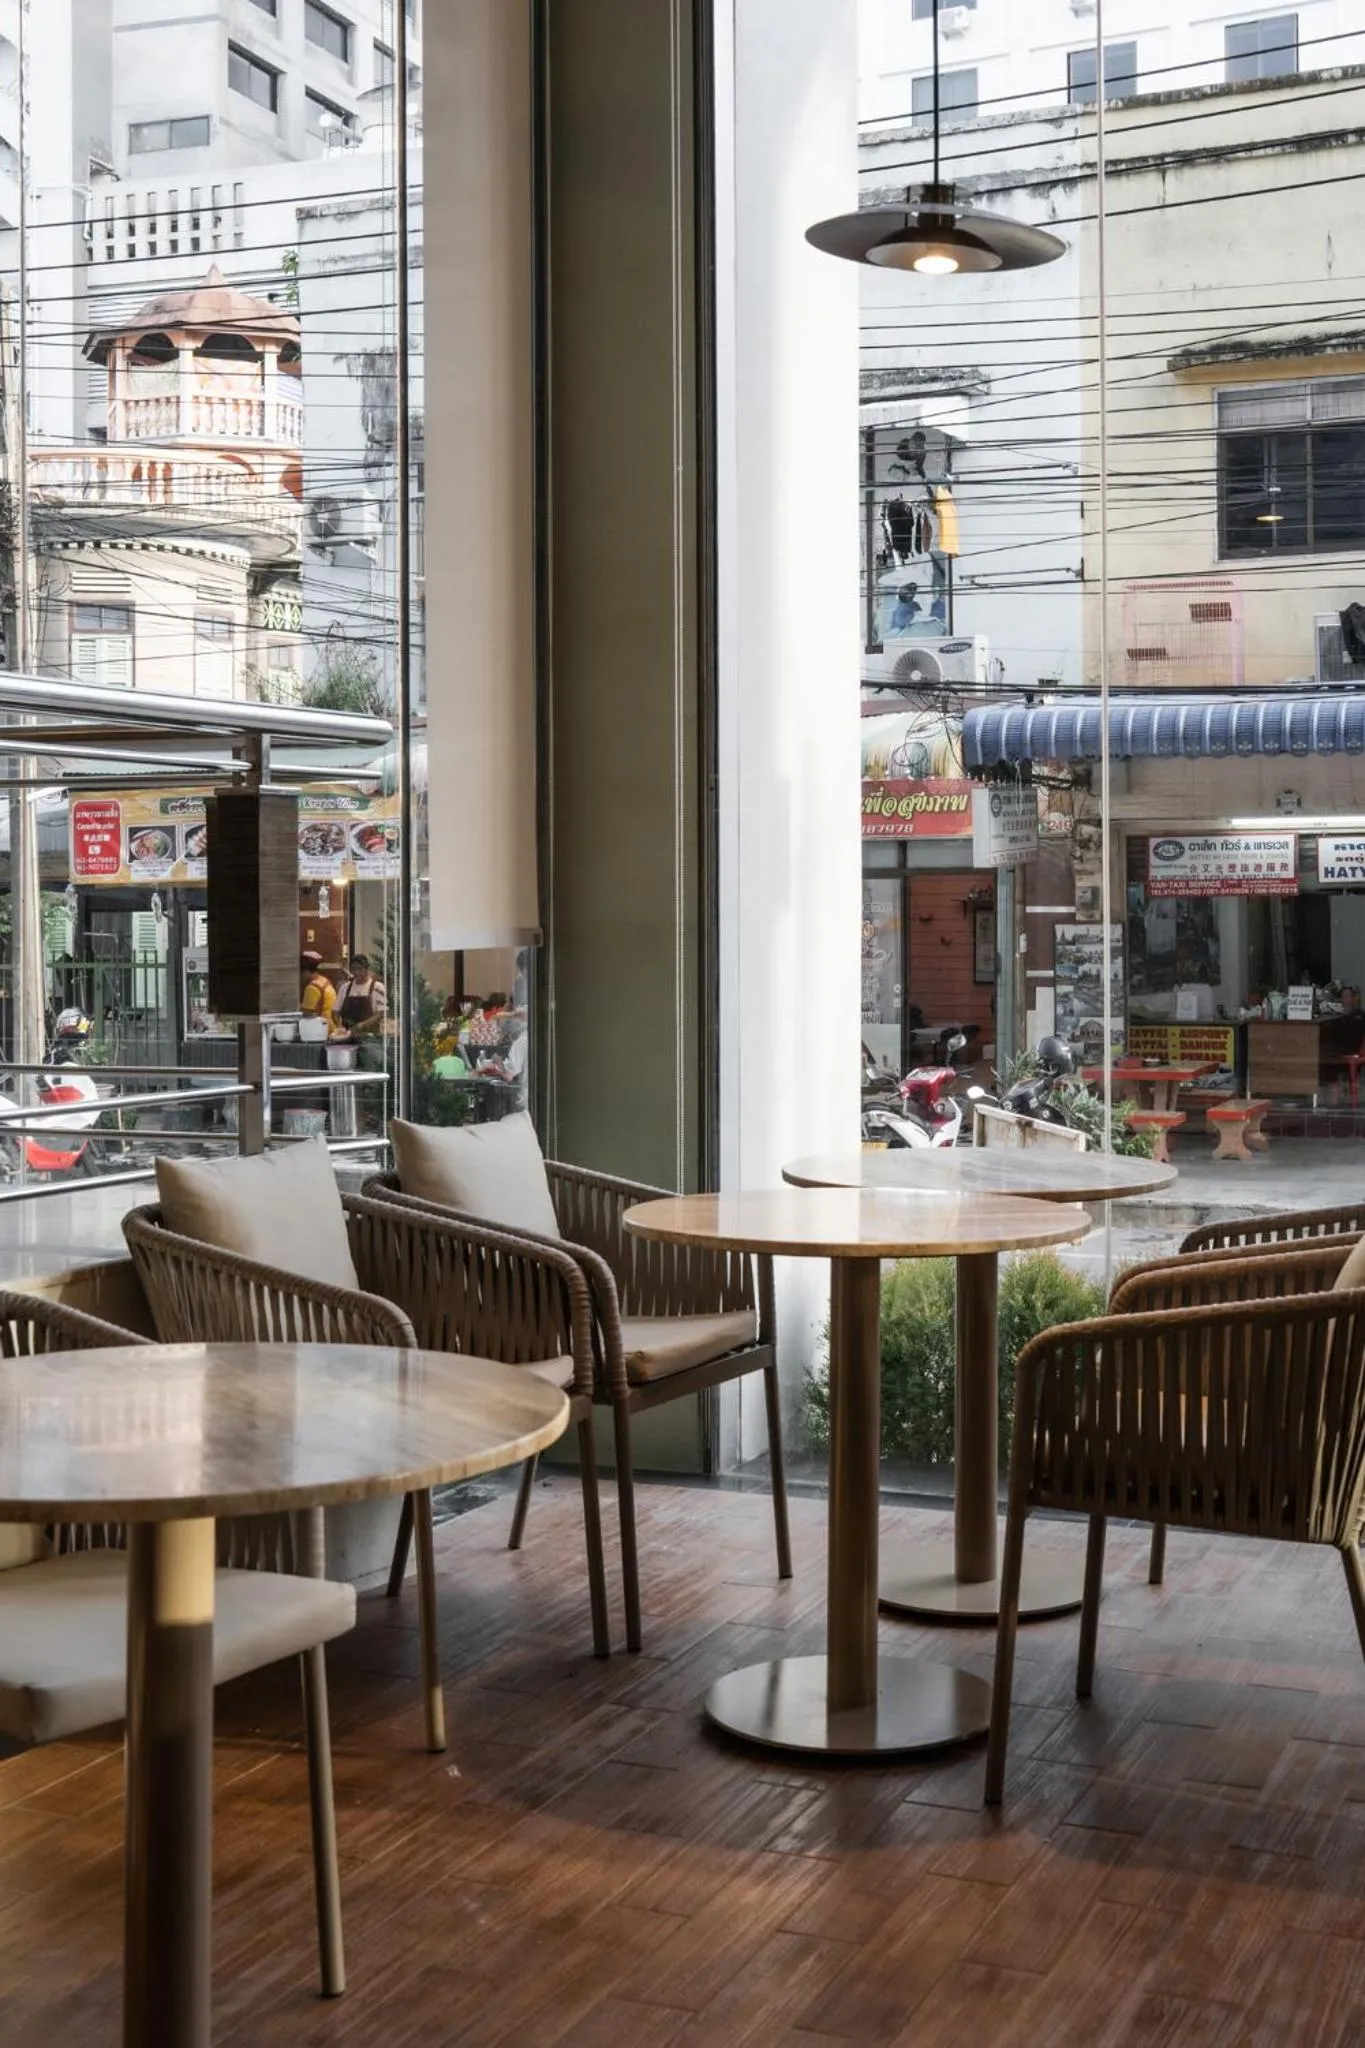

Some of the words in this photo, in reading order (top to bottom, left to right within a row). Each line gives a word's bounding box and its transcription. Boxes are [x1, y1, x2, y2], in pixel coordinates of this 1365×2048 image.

[1221, 839, 1241, 851] ทัวร์
[1244, 842, 1251, 850] &
[1179, 1029, 1231, 1039] AIRPORT
